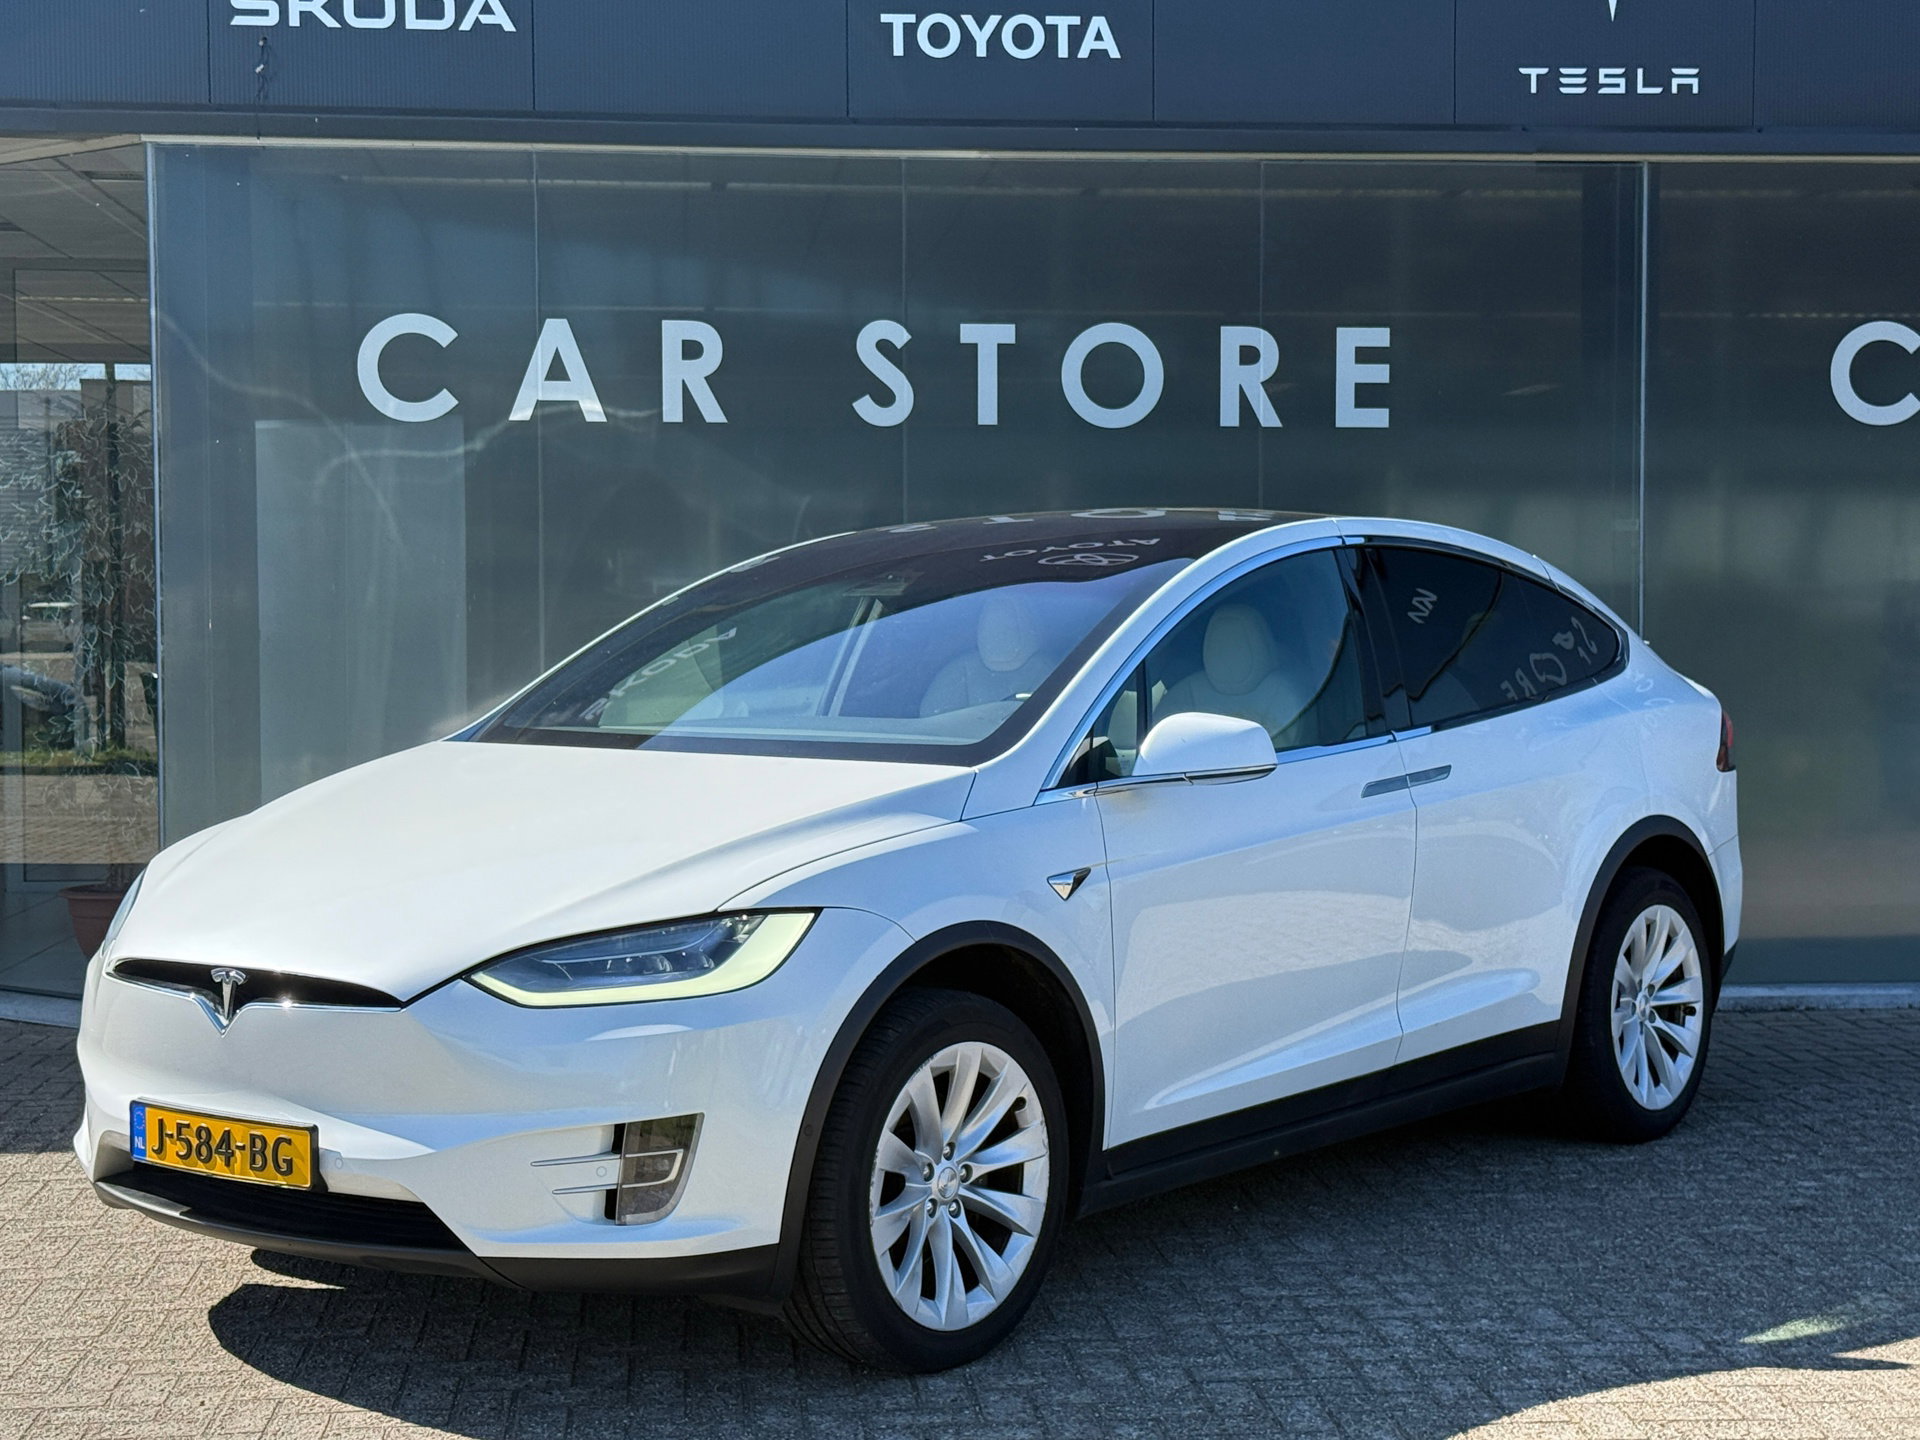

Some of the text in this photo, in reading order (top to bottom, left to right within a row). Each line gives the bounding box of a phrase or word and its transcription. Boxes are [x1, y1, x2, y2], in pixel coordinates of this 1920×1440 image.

[881, 13, 1121, 60] TOYOTA
[1518, 67, 1700, 95] TESLA
[357, 312, 1391, 429] CAR STORE
[134, 1135, 146, 1150] NL
[151, 1116, 294, 1177] J-584-BG
